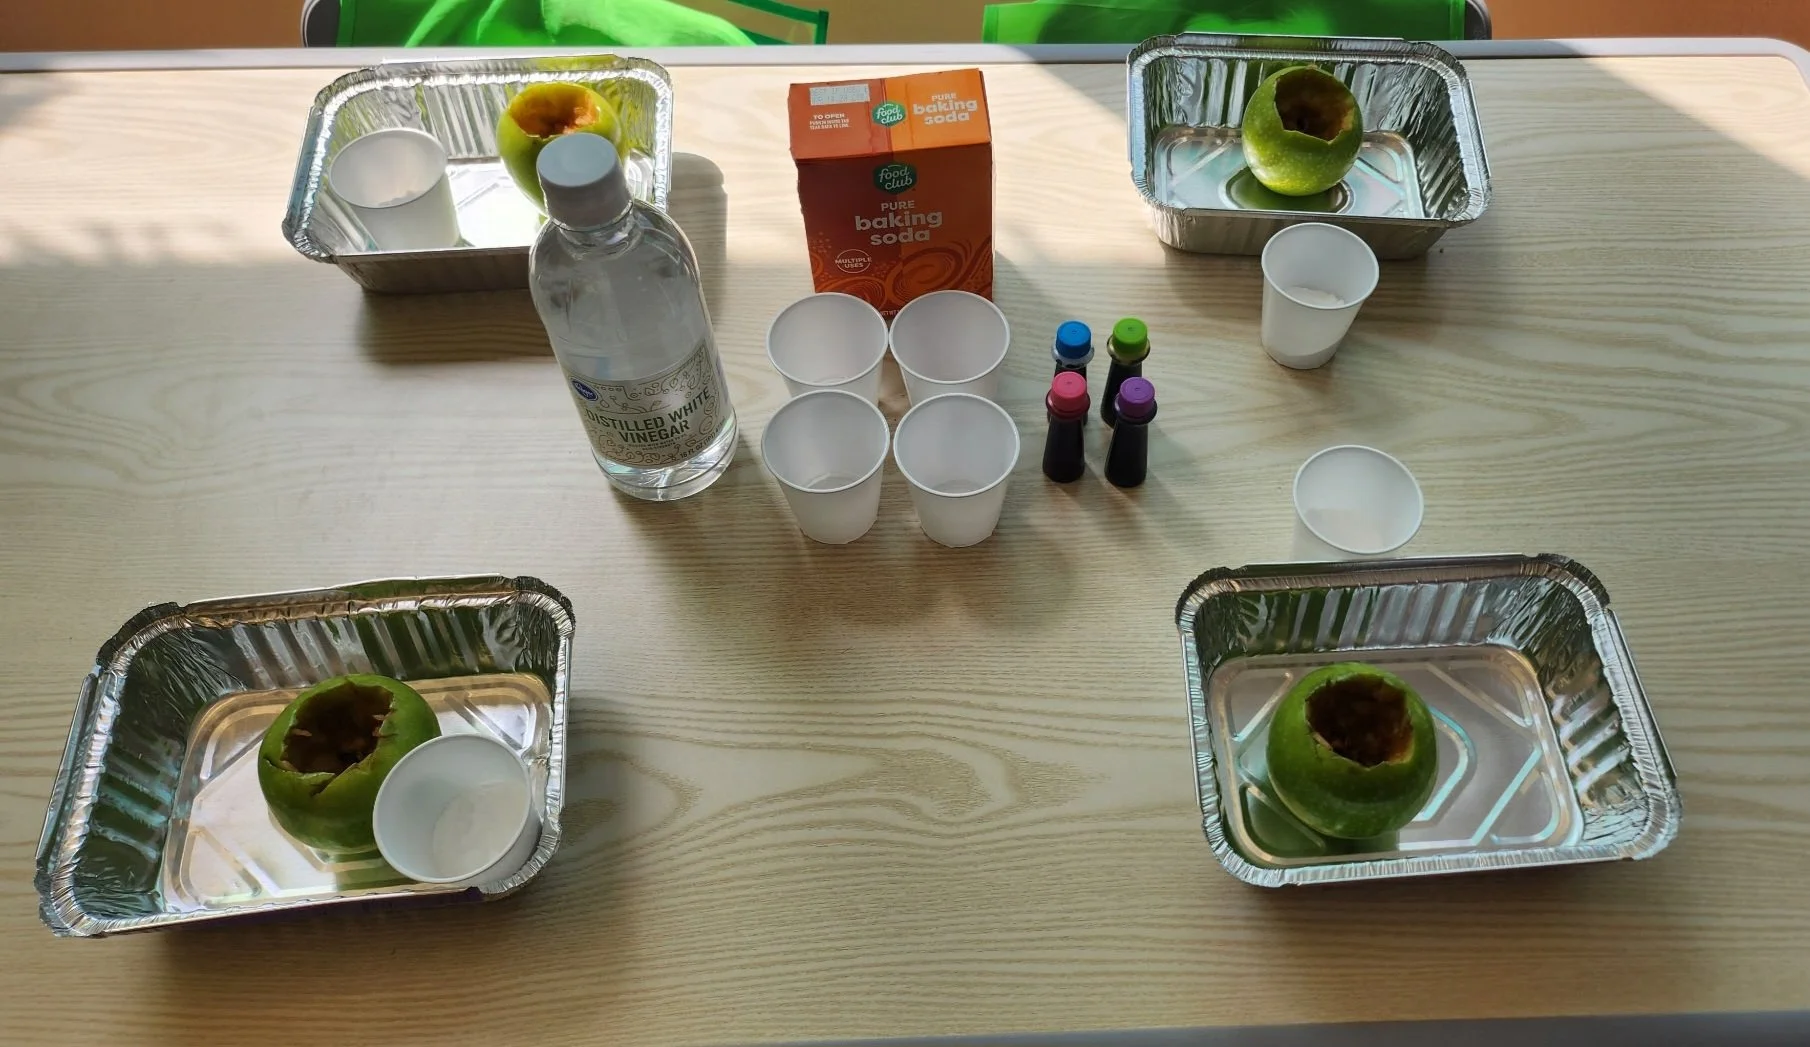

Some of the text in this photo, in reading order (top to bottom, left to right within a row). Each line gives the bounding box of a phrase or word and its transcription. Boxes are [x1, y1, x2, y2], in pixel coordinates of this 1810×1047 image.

[931, 92, 957, 101] PURE
[876, 103, 900, 120] food
[913, 99, 977, 116] baking
[880, 112, 903, 125] club
[924, 111, 970, 126] soda
[878, 166, 910, 183] food
[884, 175, 913, 190] club
[881, 200, 915, 211] PURE
[854, 211, 943, 231] baking
[870, 227, 931, 246] soda
[834, 256, 872, 264] MULTIPLE
[586, 386, 711, 432] DISTILLED WHITE
[619, 420, 690, 444] VINEGAR
[680, 451, 688, 459] 16
